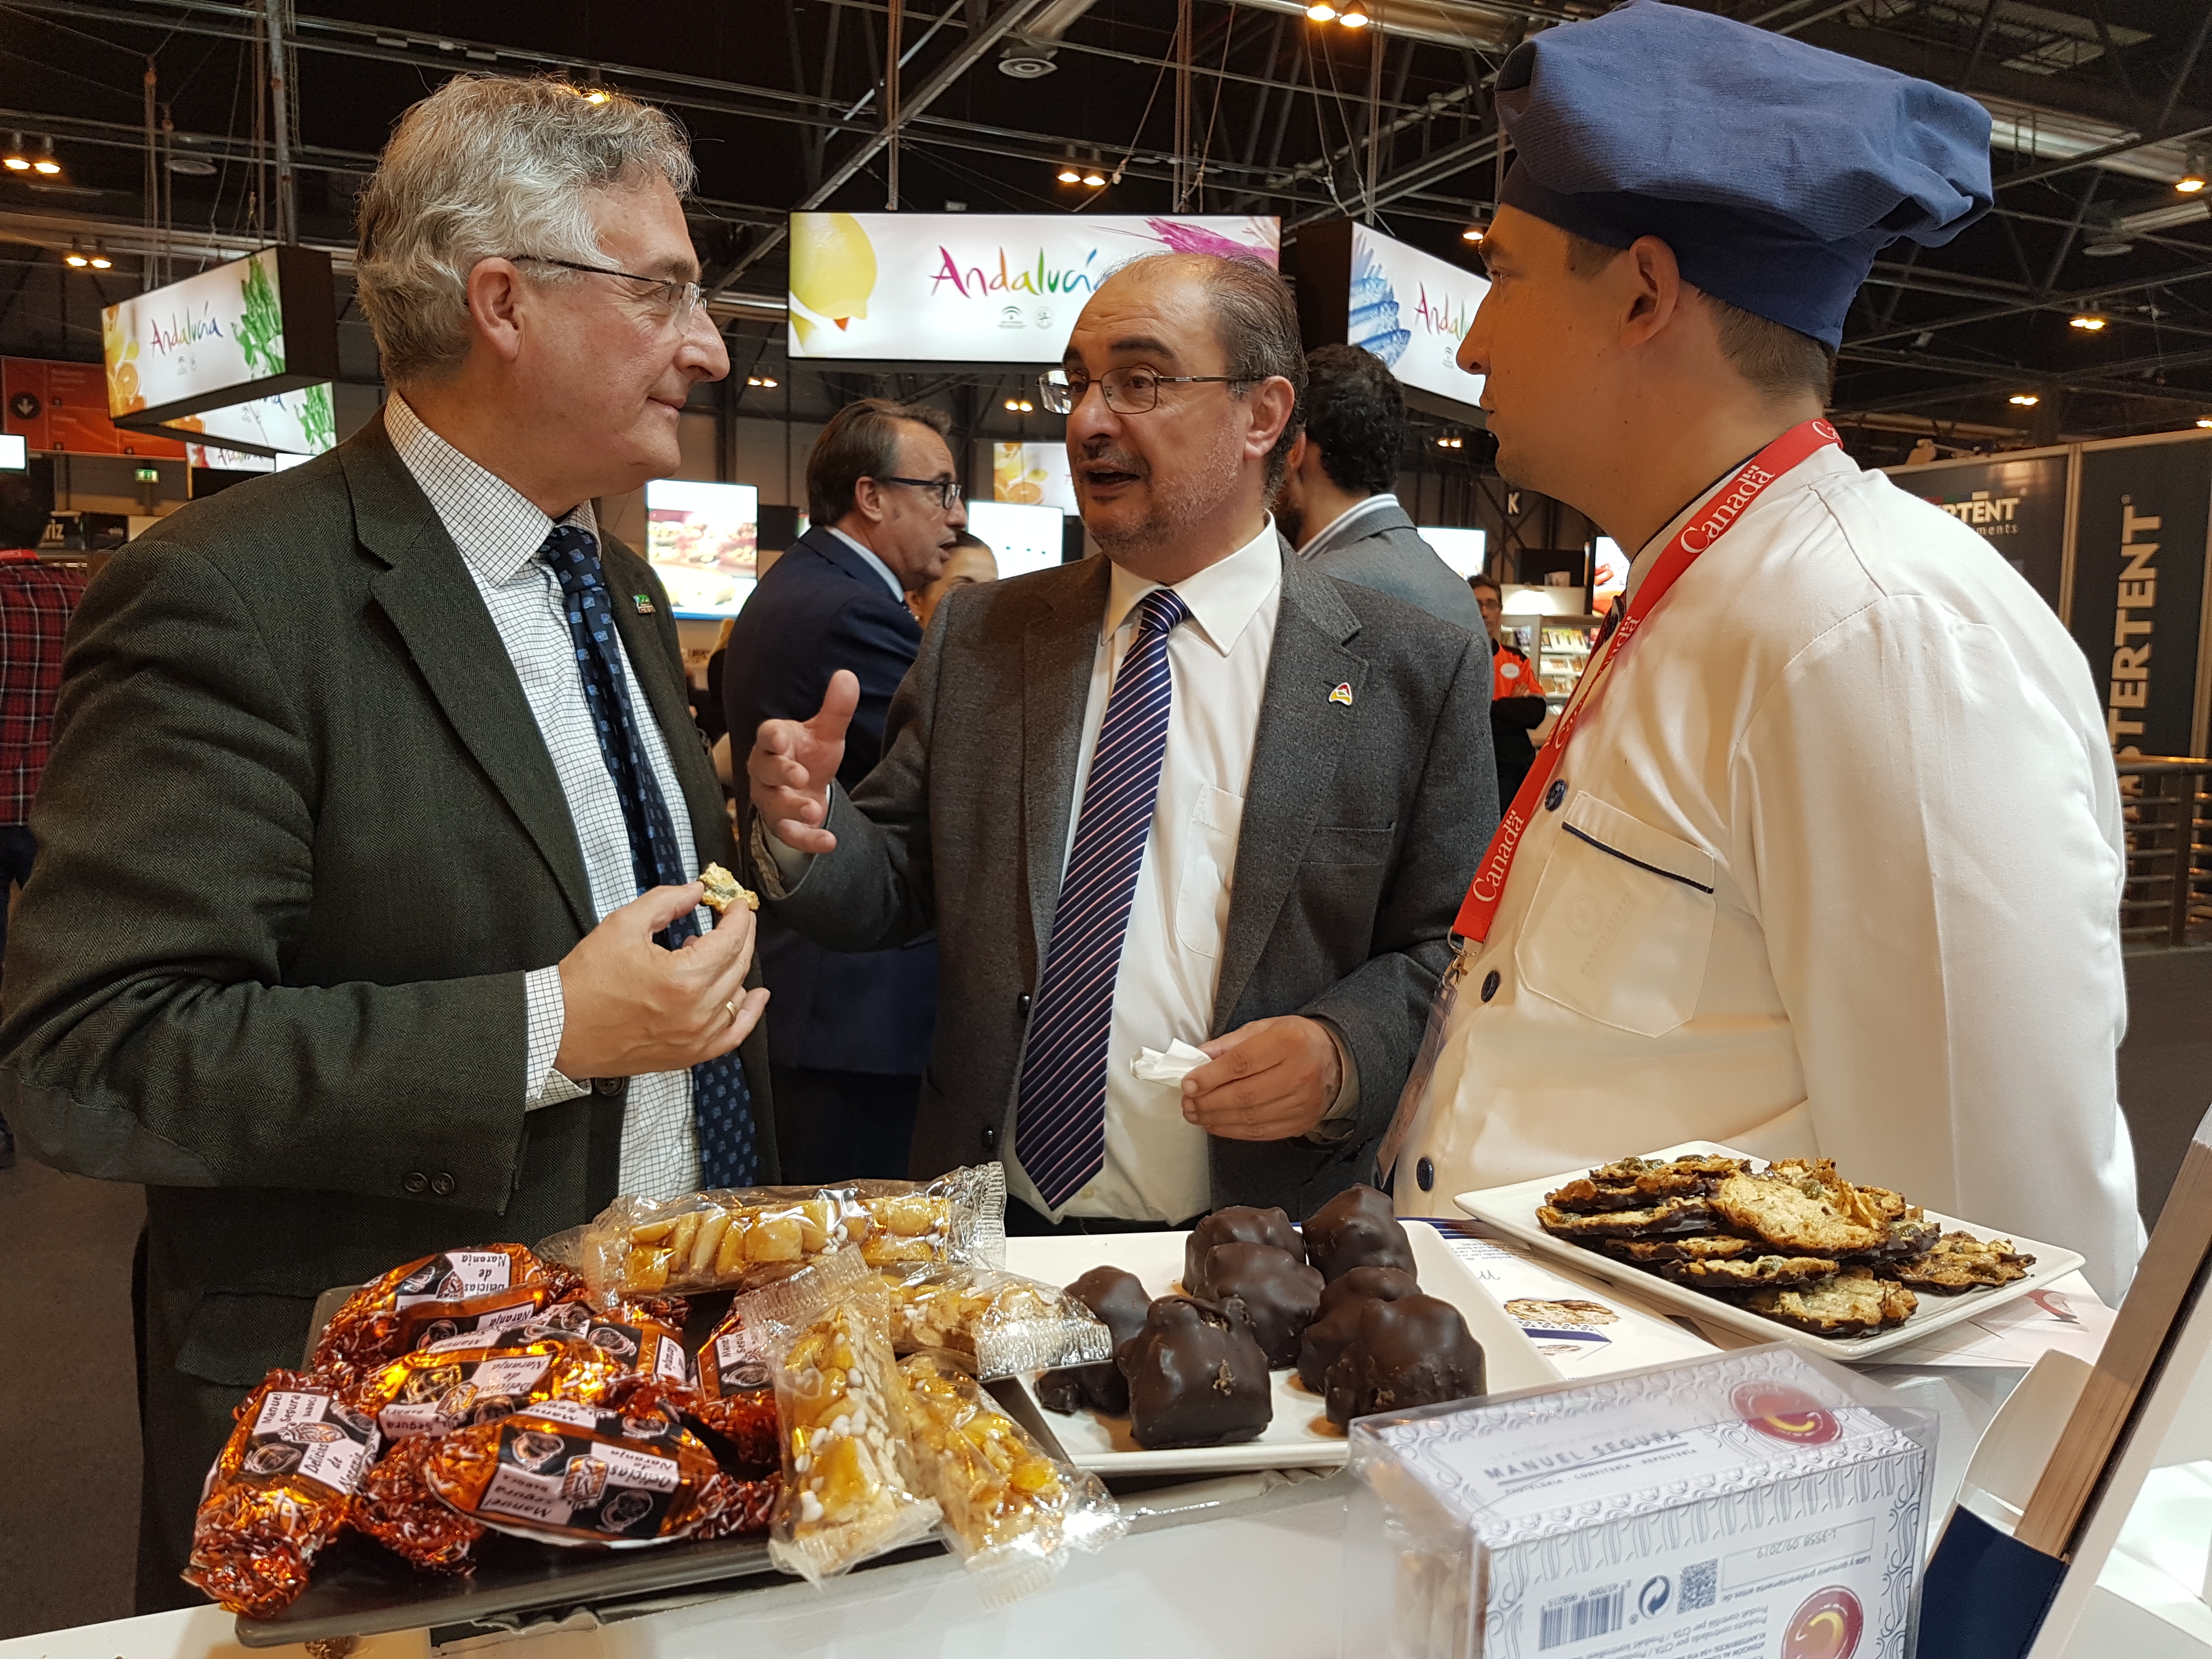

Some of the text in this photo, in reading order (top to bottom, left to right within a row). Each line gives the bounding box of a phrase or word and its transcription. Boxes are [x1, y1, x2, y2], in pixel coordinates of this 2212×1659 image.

[929, 245, 1099, 298] Andalucí
[150, 301, 224, 357] Andalucía
[1508, 492, 1520, 515] K
[1680, 465, 1775, 554] Canada
[1473, 809, 1525, 901] Canada
[478, 1268, 492, 1282] de
[492, 1359, 546, 1370] Naranja
[504, 1372, 521, 1380] de
[262, 1393, 283, 1424] Manuel
[280, 1395, 301, 1423] Segura
[327, 1455, 344, 1469] de
[610, 1449, 673, 1470] Naranja
[1484, 1450, 1585, 1479] MANUEL
[1592, 1429, 1681, 1456] SEGURA
[484, 1498, 552, 1518] Manuel
